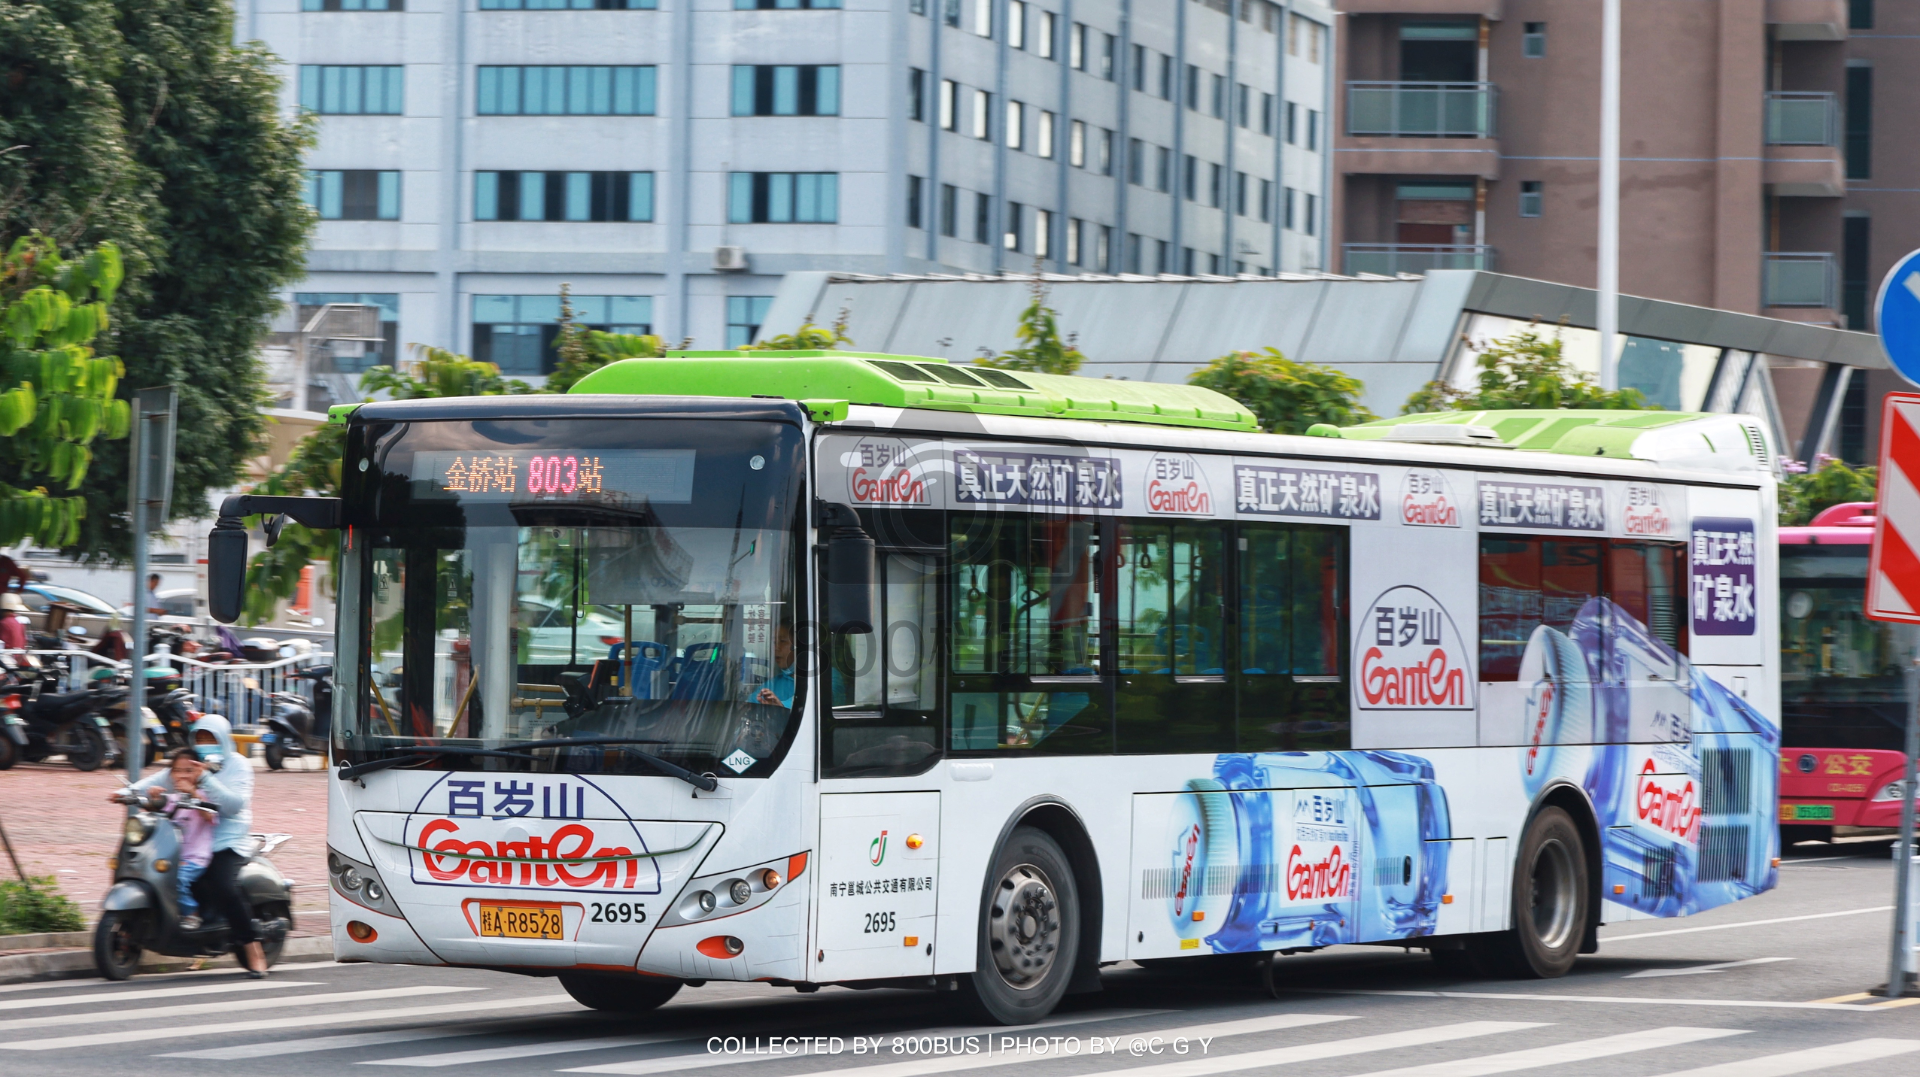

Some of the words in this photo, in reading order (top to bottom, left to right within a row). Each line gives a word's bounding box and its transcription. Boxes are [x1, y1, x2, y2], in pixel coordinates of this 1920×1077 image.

[443, 456, 519, 493] 金桥站
[860, 444, 906, 468] 百岁山
[1155, 458, 1195, 480] 百岁山
[852, 467, 924, 503] Ganten
[957, 453, 1121, 506] 真正天然矿泉水
[1148, 479, 1210, 513] Ganten
[1237, 468, 1379, 518] 真正天然矿泉水
[1480, 483, 1604, 529] 真正天然矿泉水
[1693, 529, 1754, 566] 真正天然
[1693, 574, 1754, 622] 矿泉水
[1375, 606, 1442, 647] 百岁山
[1361, 646, 1465, 706] Ganten
[728, 756, 751, 766] LNG
[447, 779, 585, 821] 百岁山
[417, 817, 639, 889] Ganten
[1286, 844, 1351, 901] Ganten
[590, 902, 647, 924] 2695
[863, 911, 896, 934] 2695
